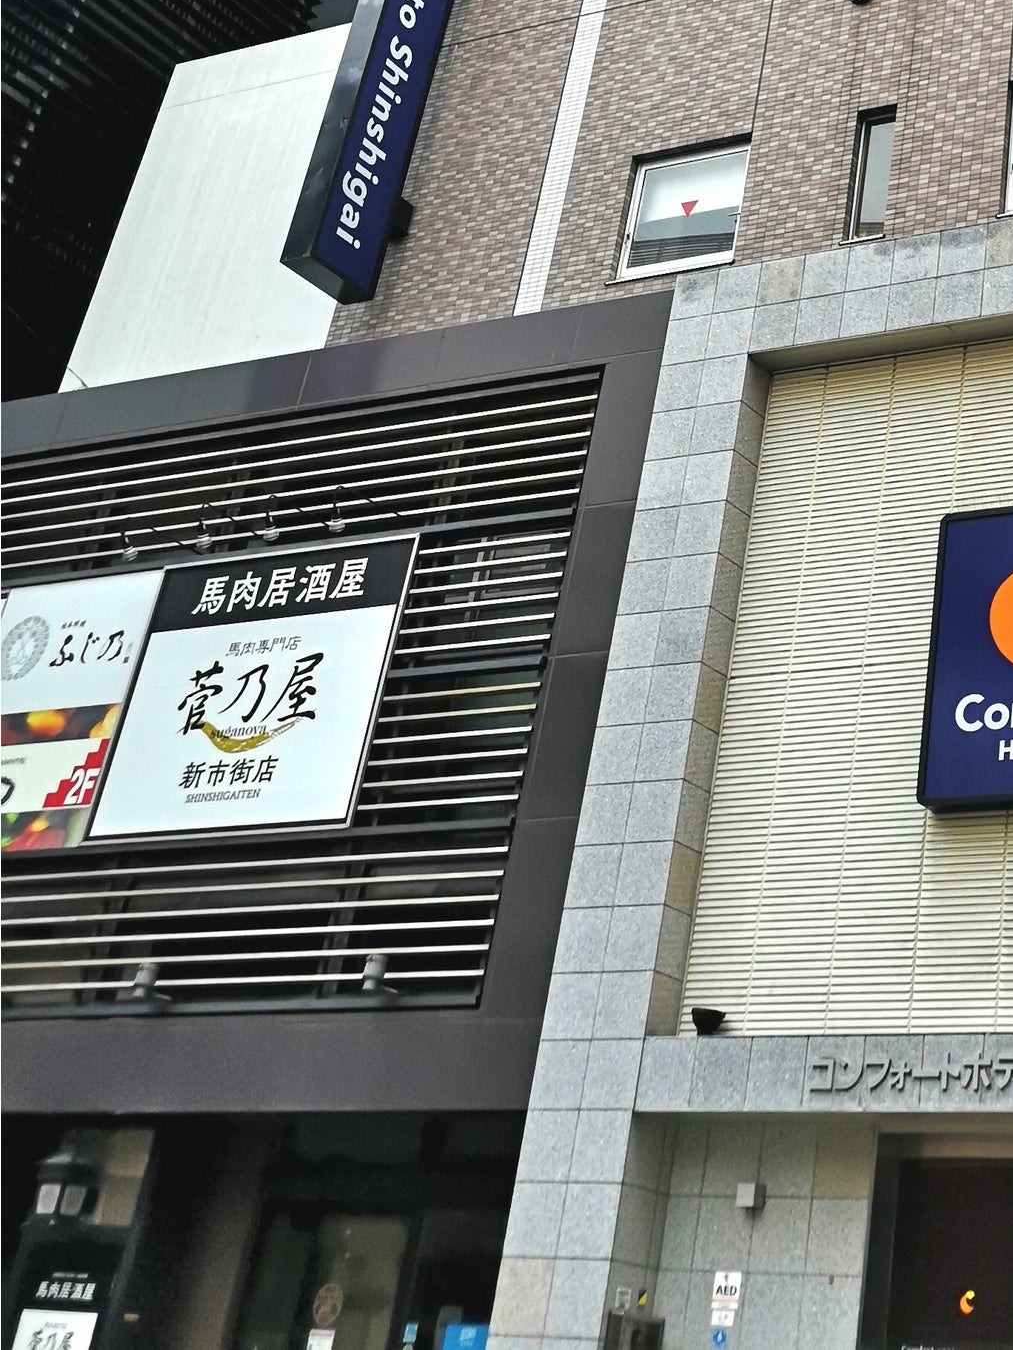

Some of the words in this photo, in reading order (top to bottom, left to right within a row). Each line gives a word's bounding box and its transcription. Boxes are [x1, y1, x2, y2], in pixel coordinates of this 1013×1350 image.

[336, 35, 413, 250] Shinshigai
[191, 557, 369, 616] 馬肉居酒屋
[225, 635, 302, 657] 馬肉専門店
[176, 652, 324, 736] 菅乃屋
[63, 767, 100, 805] 2F
[178, 755, 279, 790] 新市街店
[184, 788, 262, 804] SHINSHIGAITEN
[716, 1284, 738, 1296] AED
